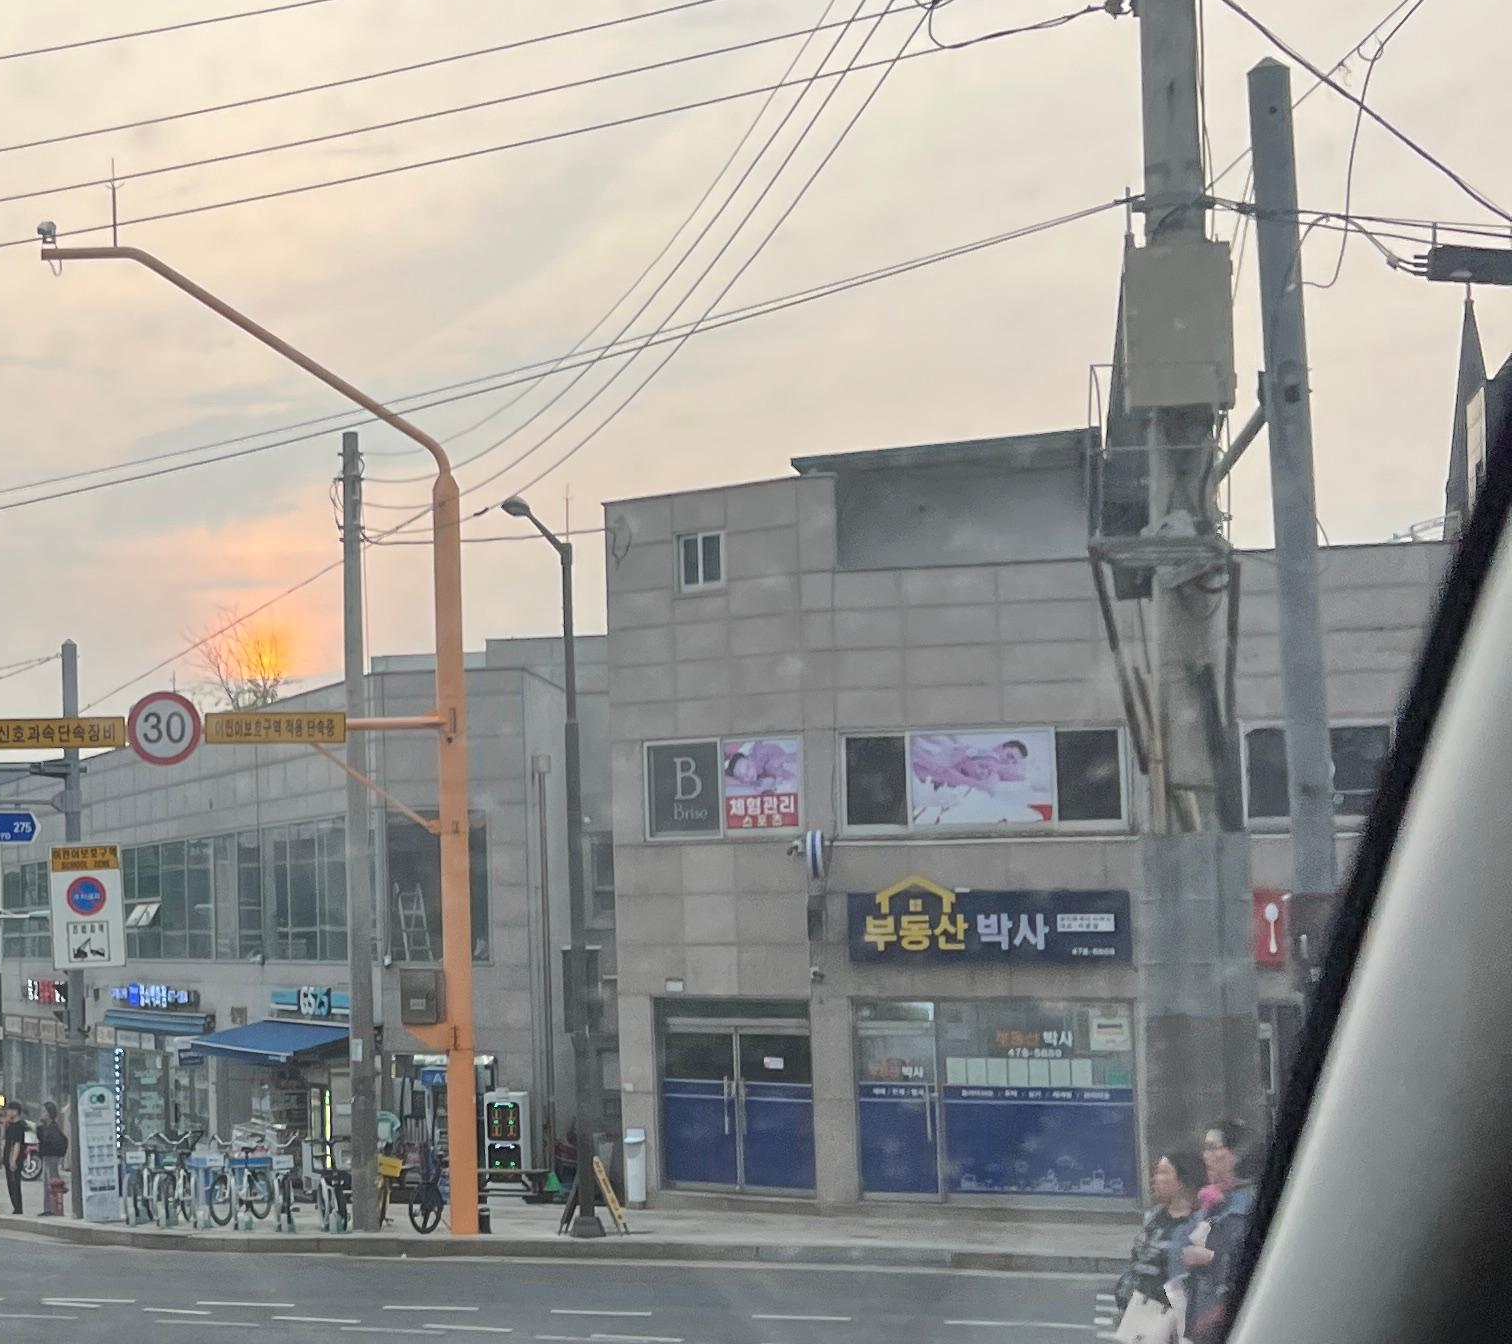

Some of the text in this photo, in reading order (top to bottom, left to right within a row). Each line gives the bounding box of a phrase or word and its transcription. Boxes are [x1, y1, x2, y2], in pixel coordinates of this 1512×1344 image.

[143, 712, 186, 745] 30
[215, 719, 282, 738] 어린이보호구역
[673, 757, 703, 800] B
[13, 820, 32, 834] 275
[864, 912, 1050, 952] 부동산 박사
[300, 985, 330, 1017] GS25
[1043, 1030, 1074, 1048] 박사
